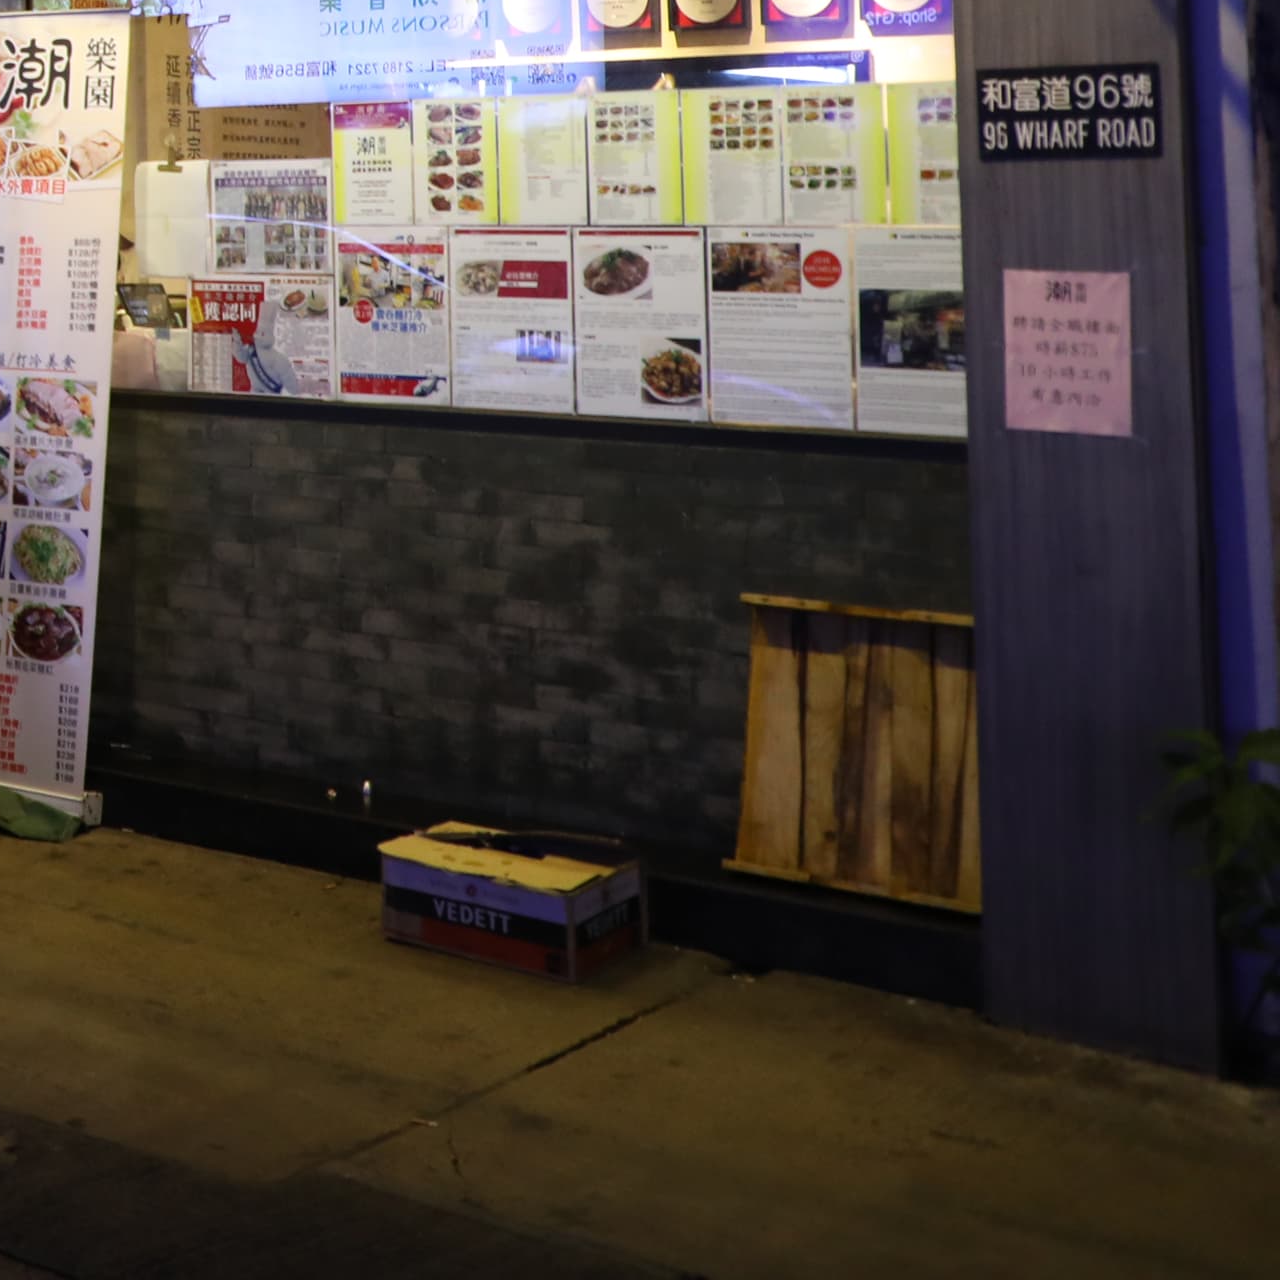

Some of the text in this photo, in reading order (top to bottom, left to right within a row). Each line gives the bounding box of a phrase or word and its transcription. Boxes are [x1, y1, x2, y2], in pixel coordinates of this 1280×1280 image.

[83, 37, 117, 111] 樂園
[981, 72, 1155, 114] 和富道96號
[981, 112, 1157, 152] 96 WHARF ROAD
[431, 896, 513, 936] VEDETT
